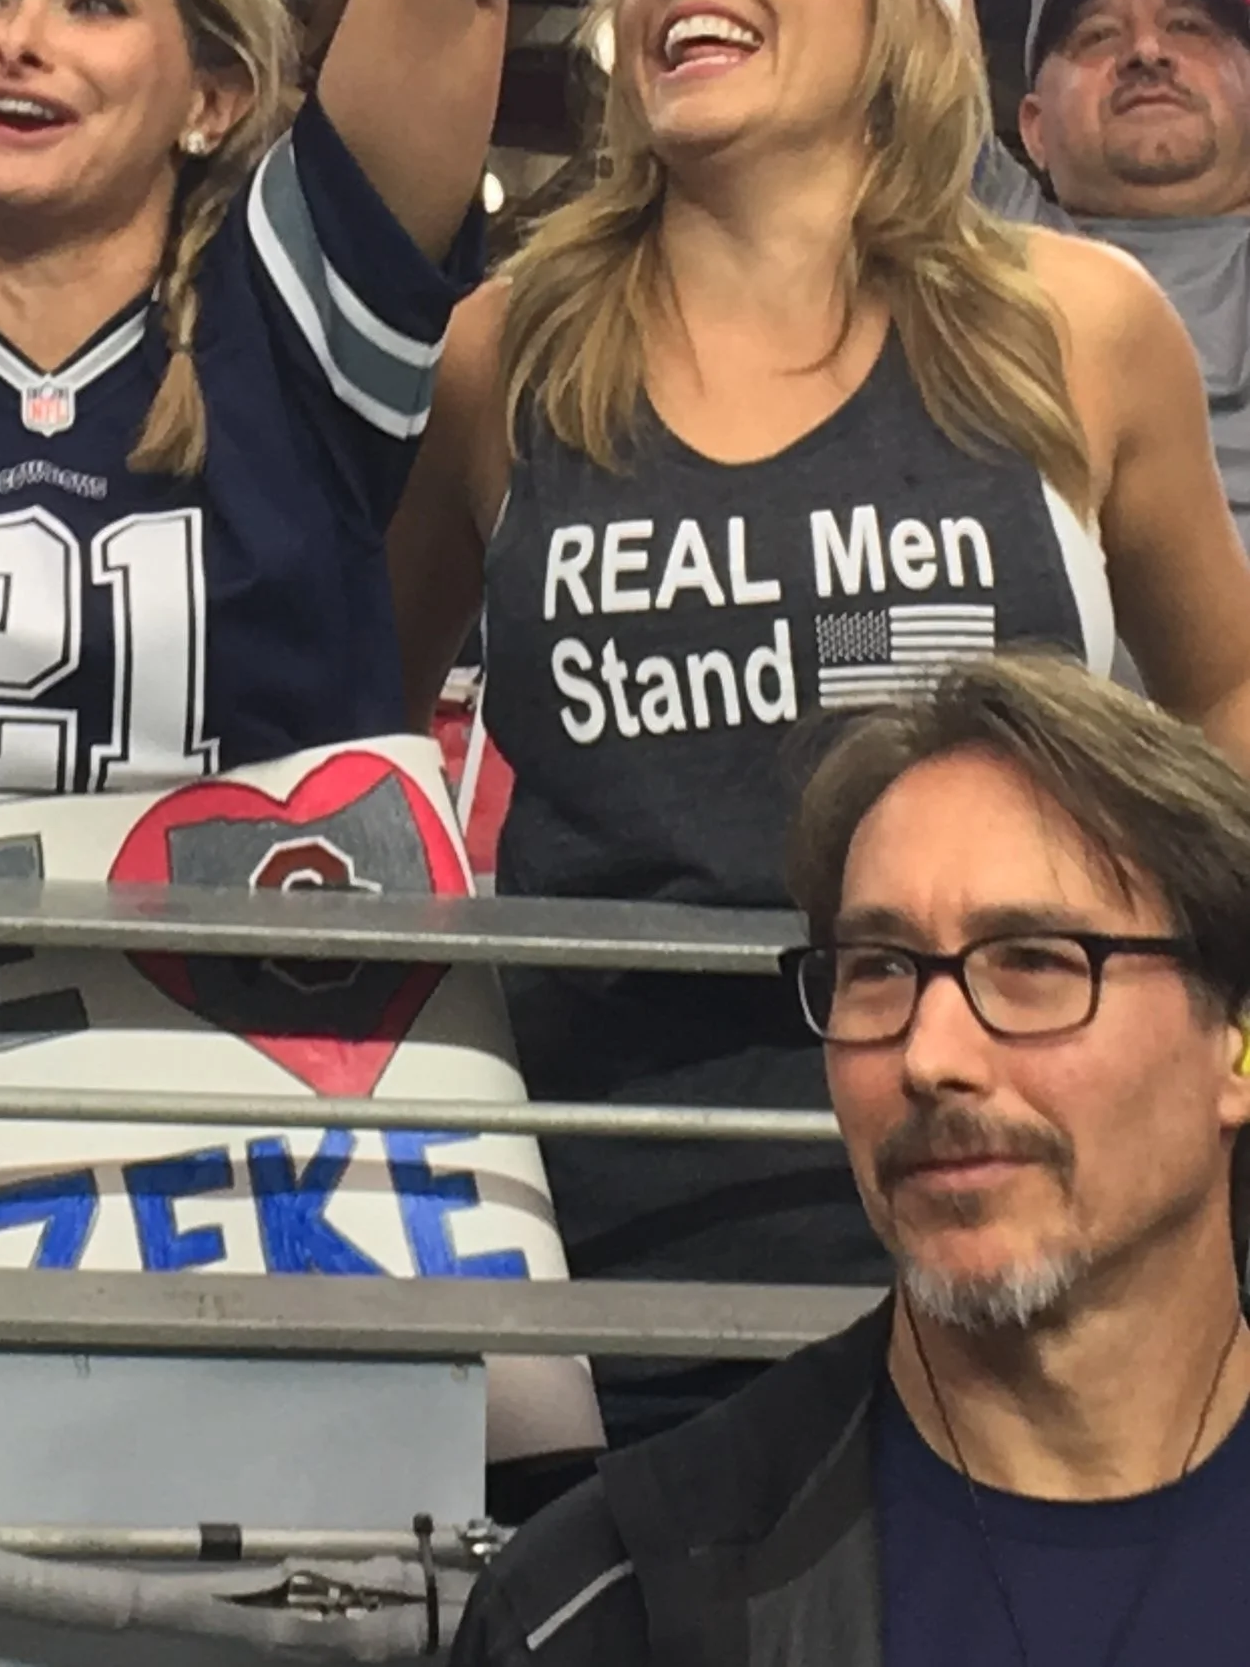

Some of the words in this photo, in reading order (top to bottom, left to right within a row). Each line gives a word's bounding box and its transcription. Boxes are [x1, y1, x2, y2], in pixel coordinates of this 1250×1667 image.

[543, 516, 781, 621] REAL
[810, 504, 995, 598] Men
[551, 618, 798, 744] Stand
